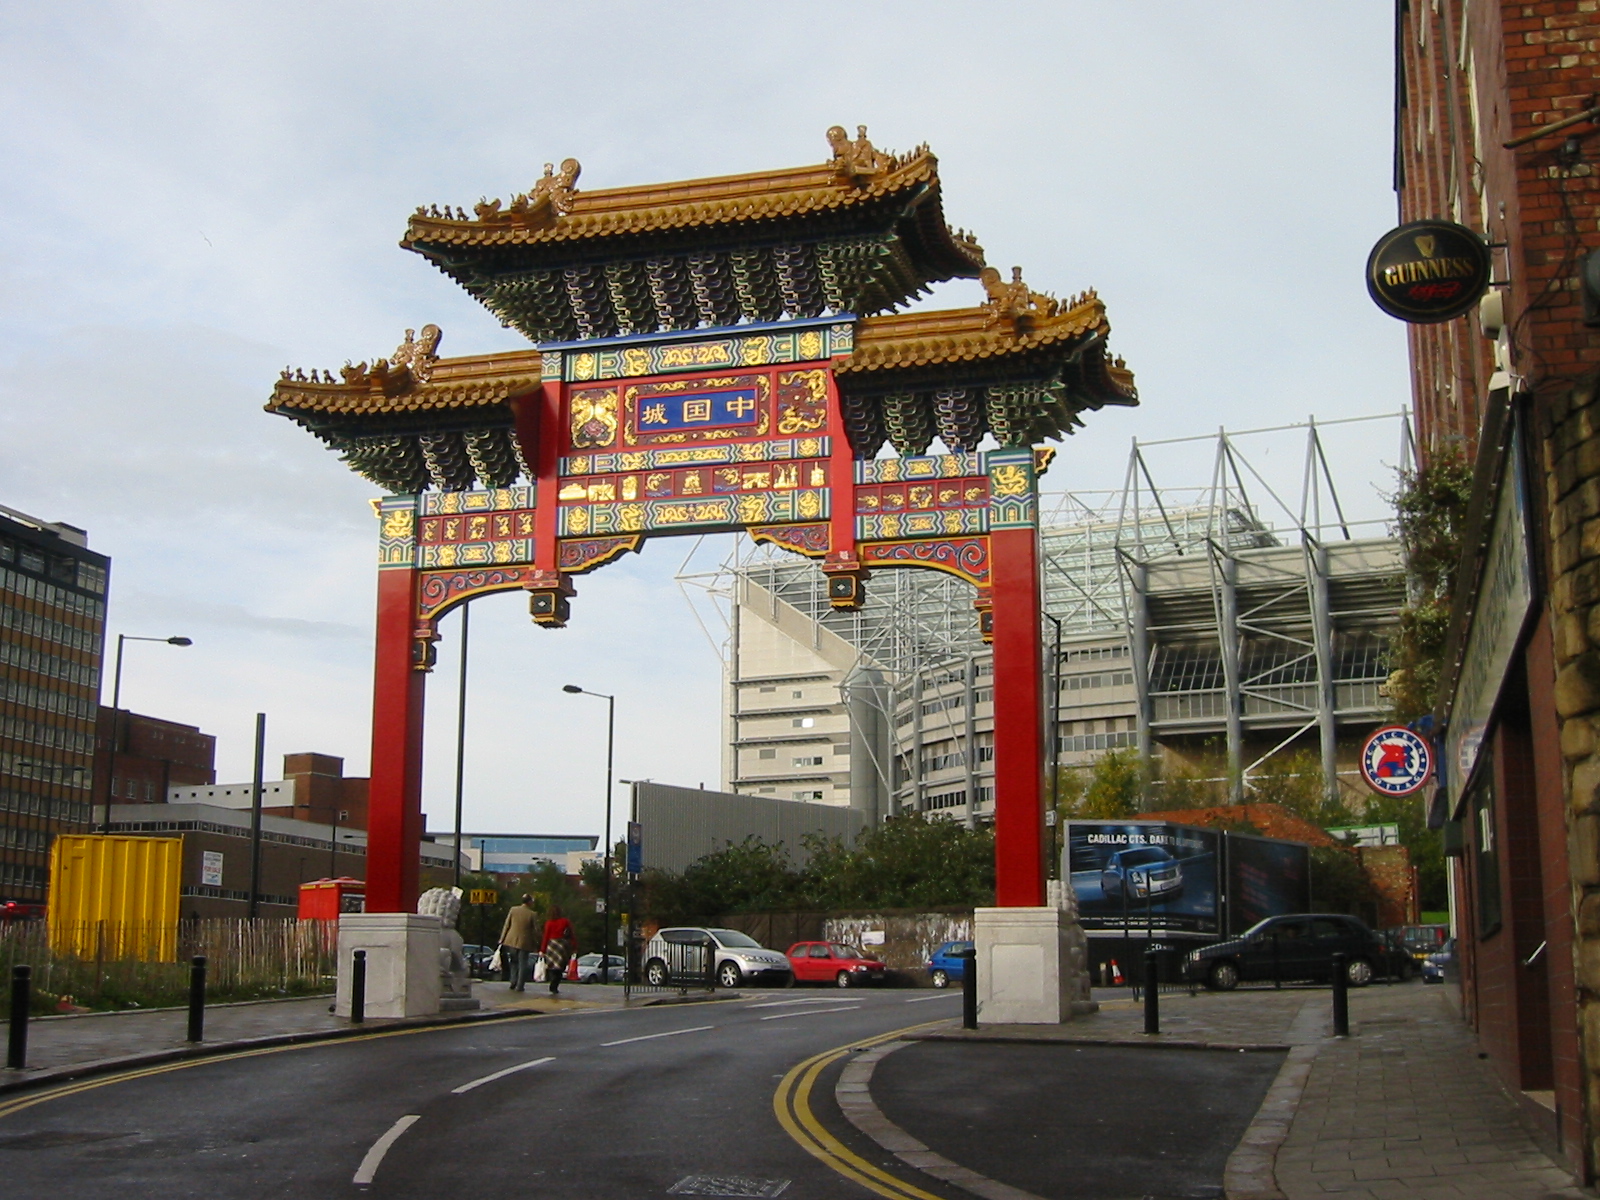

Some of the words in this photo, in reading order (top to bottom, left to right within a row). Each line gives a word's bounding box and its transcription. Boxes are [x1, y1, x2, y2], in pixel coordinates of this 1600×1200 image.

[1385, 257, 1475, 287] GUINNESS
[1366, 731, 1425, 756] CHICKEN
[1368, 767, 1425, 792] COTTAGE
[1087, 833, 1127, 844] CADILLAC
